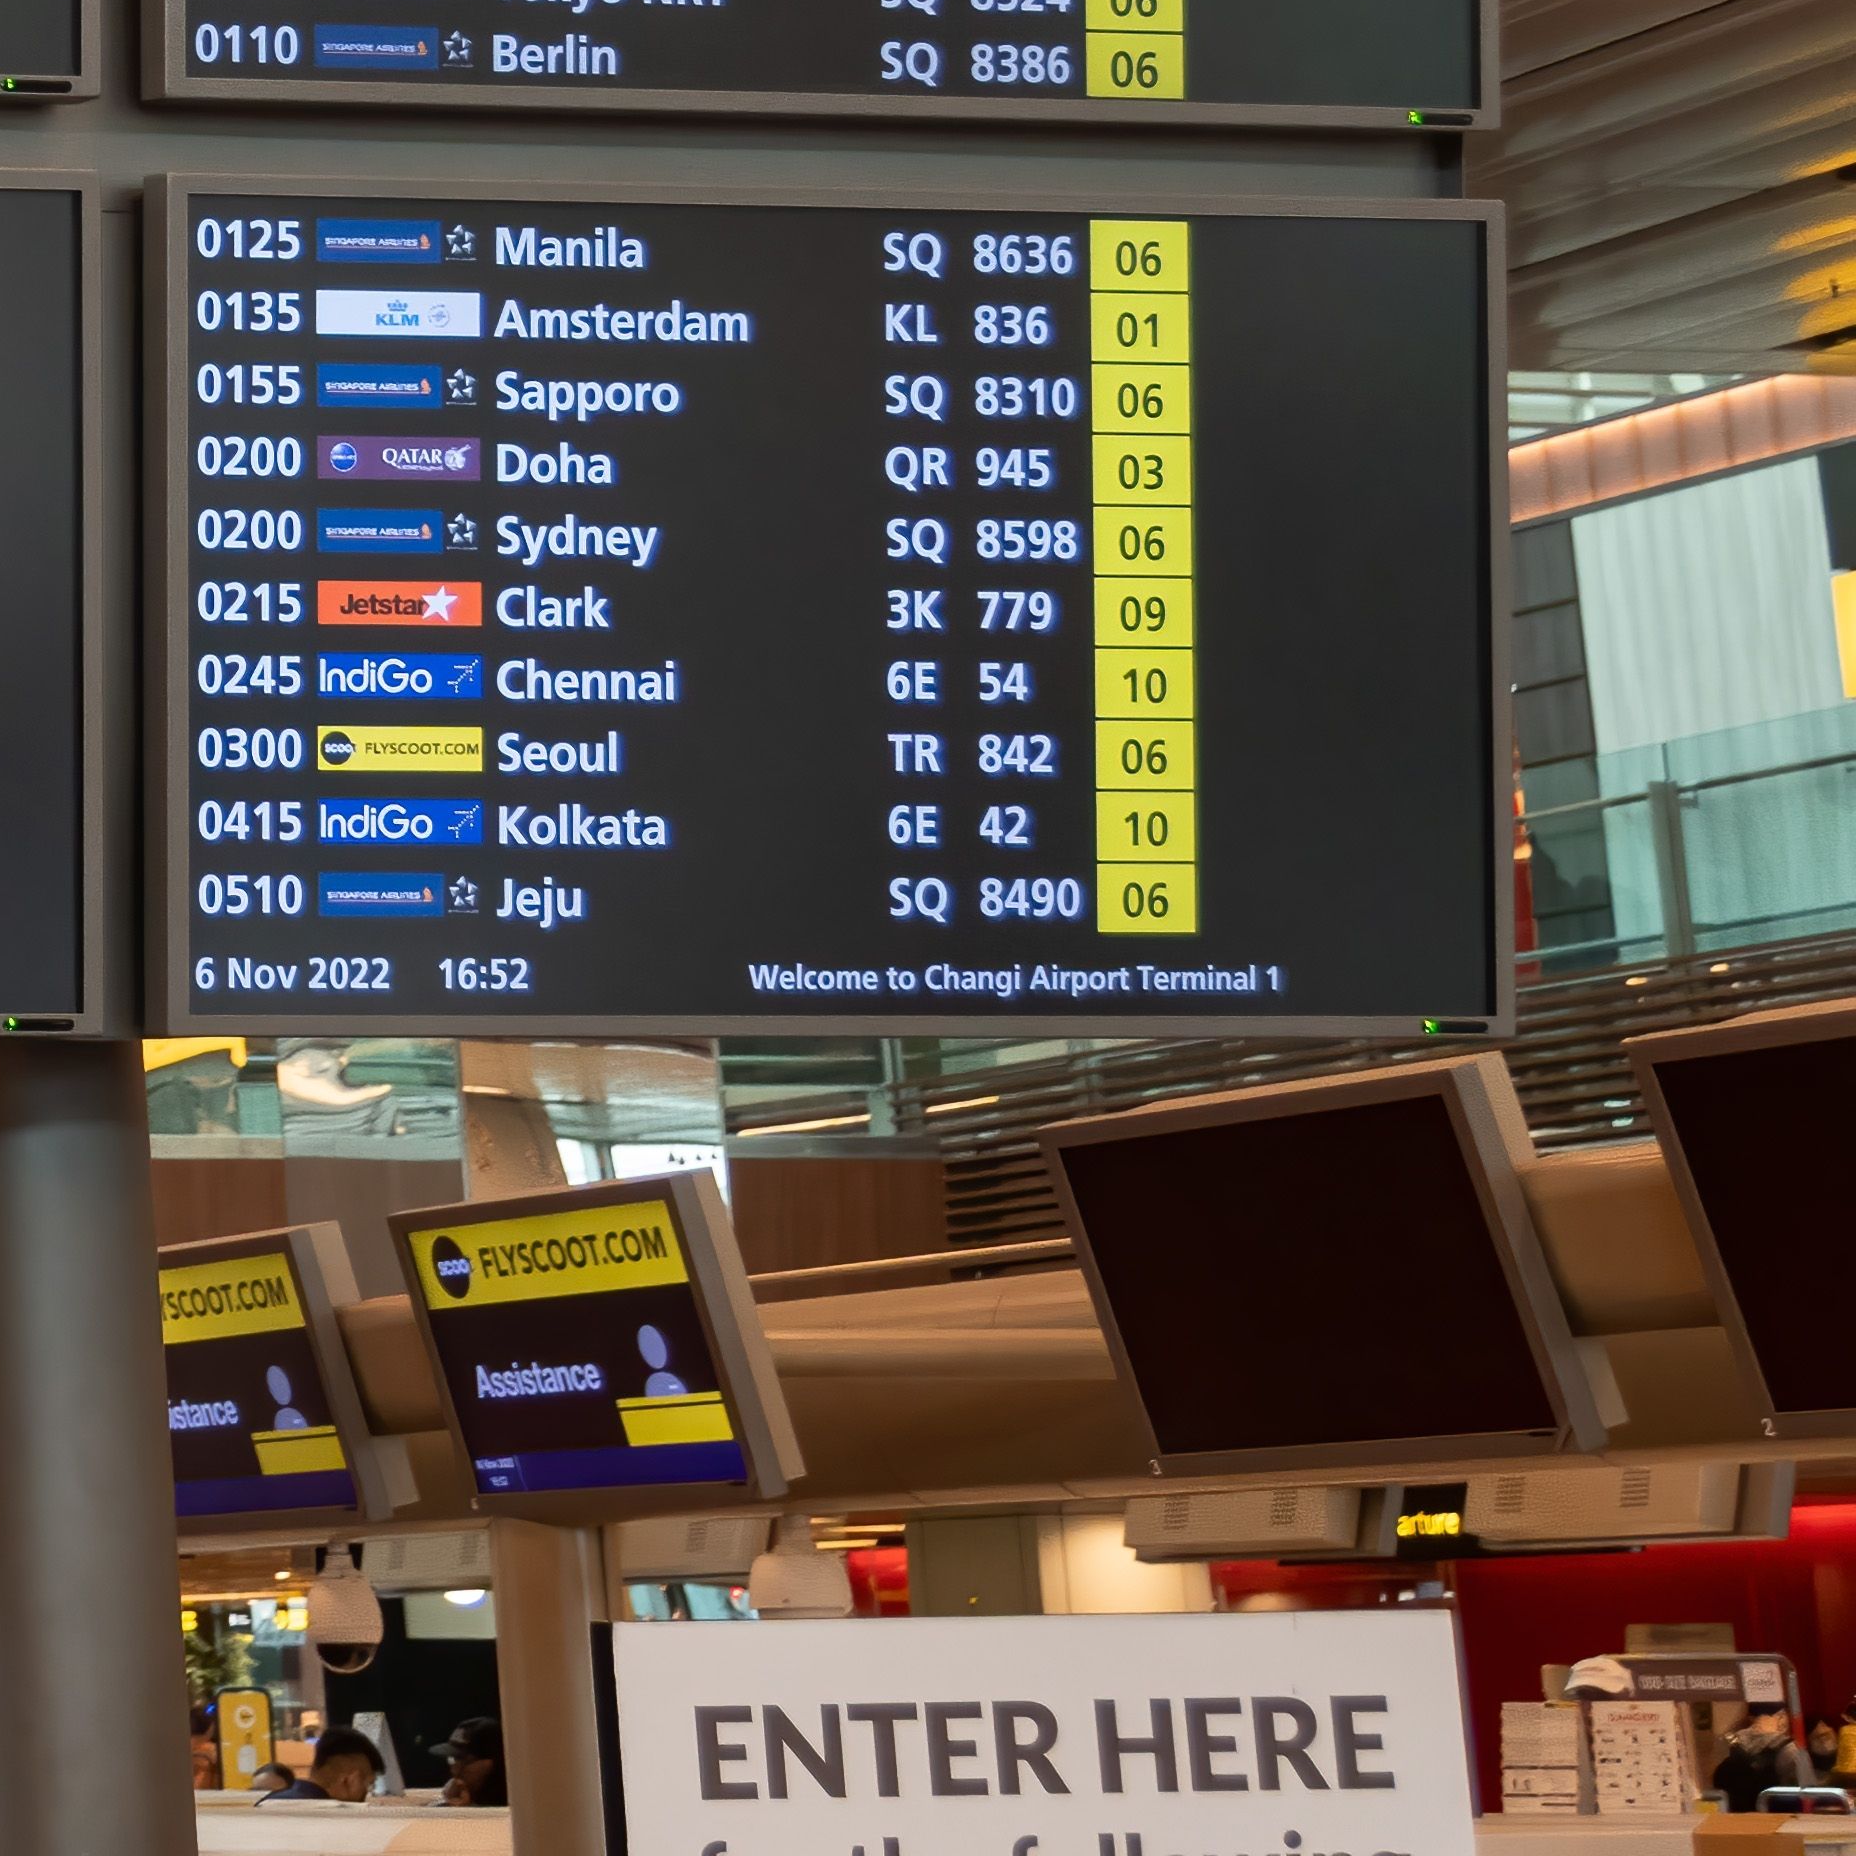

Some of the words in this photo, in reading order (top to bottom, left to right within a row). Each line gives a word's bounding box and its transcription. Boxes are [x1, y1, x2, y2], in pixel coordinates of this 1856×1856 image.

[198, 291, 300, 331] 0135
[374, 312, 420, 328] KLM
[494, 300, 747, 341] Amsterdam
[886, 304, 937, 341] KL
[975, 305, 1047, 344] 836
[1117, 313, 1157, 347] 01
[198, 655, 300, 694] 0245
[319, 658, 433, 694] IndiGo
[497, 658, 674, 700] Chennai
[888, 662, 935, 699] 6E
[980, 663, 1027, 700] 54
[1124, 669, 1166, 703] 10
[199, 728, 301, 767] 0300
[365, 741, 480, 756] FLYSCOOT.COM
[498, 731, 617, 772] Seoul
[888, 734, 940, 771] TR
[979, 734, 1052, 772] 842
[1122, 739, 1167, 774] 06
[196, 957, 214, 989] 6
[228, 958, 297, 989] Nov
[309, 958, 389, 989] 2022
[439, 958, 528, 989] 16:52
[478, 1226, 668, 1279] FLYSCOOT.COM
[475, 1361, 602, 1399] Assistance
[693, 1700, 1072, 1801] ENTER
[1093, 1694, 1396, 1794] HERE
